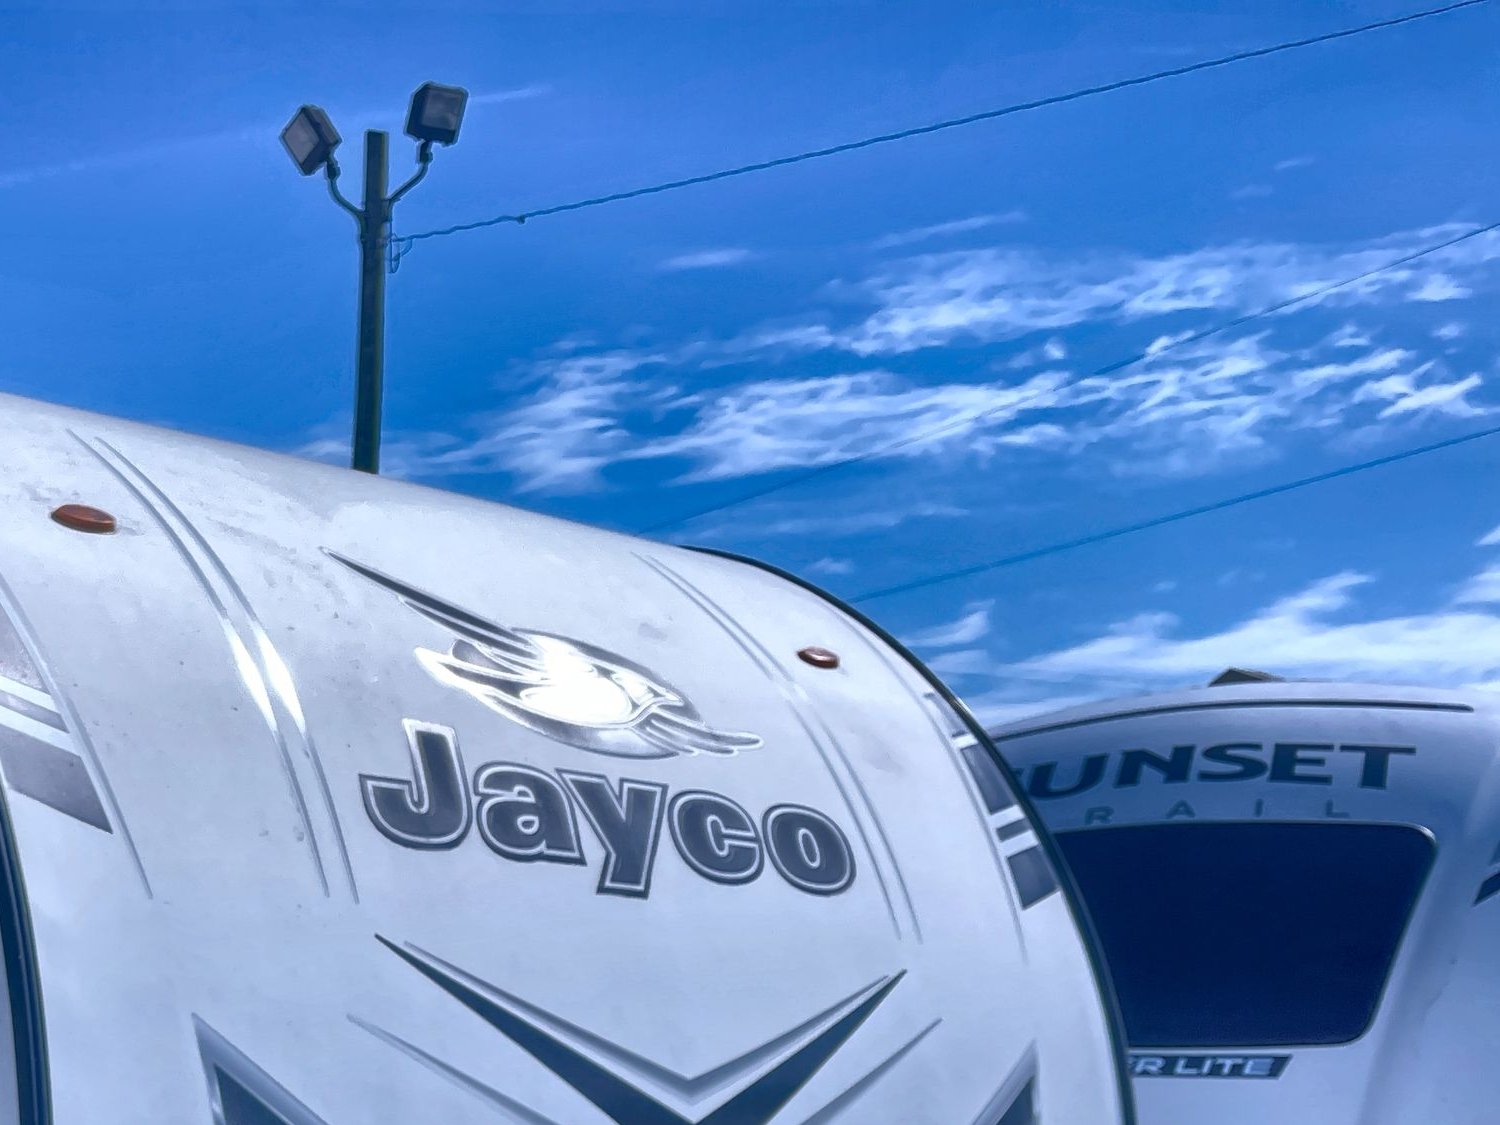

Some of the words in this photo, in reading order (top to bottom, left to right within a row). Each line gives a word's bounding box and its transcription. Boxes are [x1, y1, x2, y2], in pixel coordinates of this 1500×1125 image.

[1013, 744, 1417, 801] UNSET
[358, 718, 857, 900] Jayco
[1083, 799, 1352, 826] RAIL
[1173, 1056, 1275, 1076] LITE
